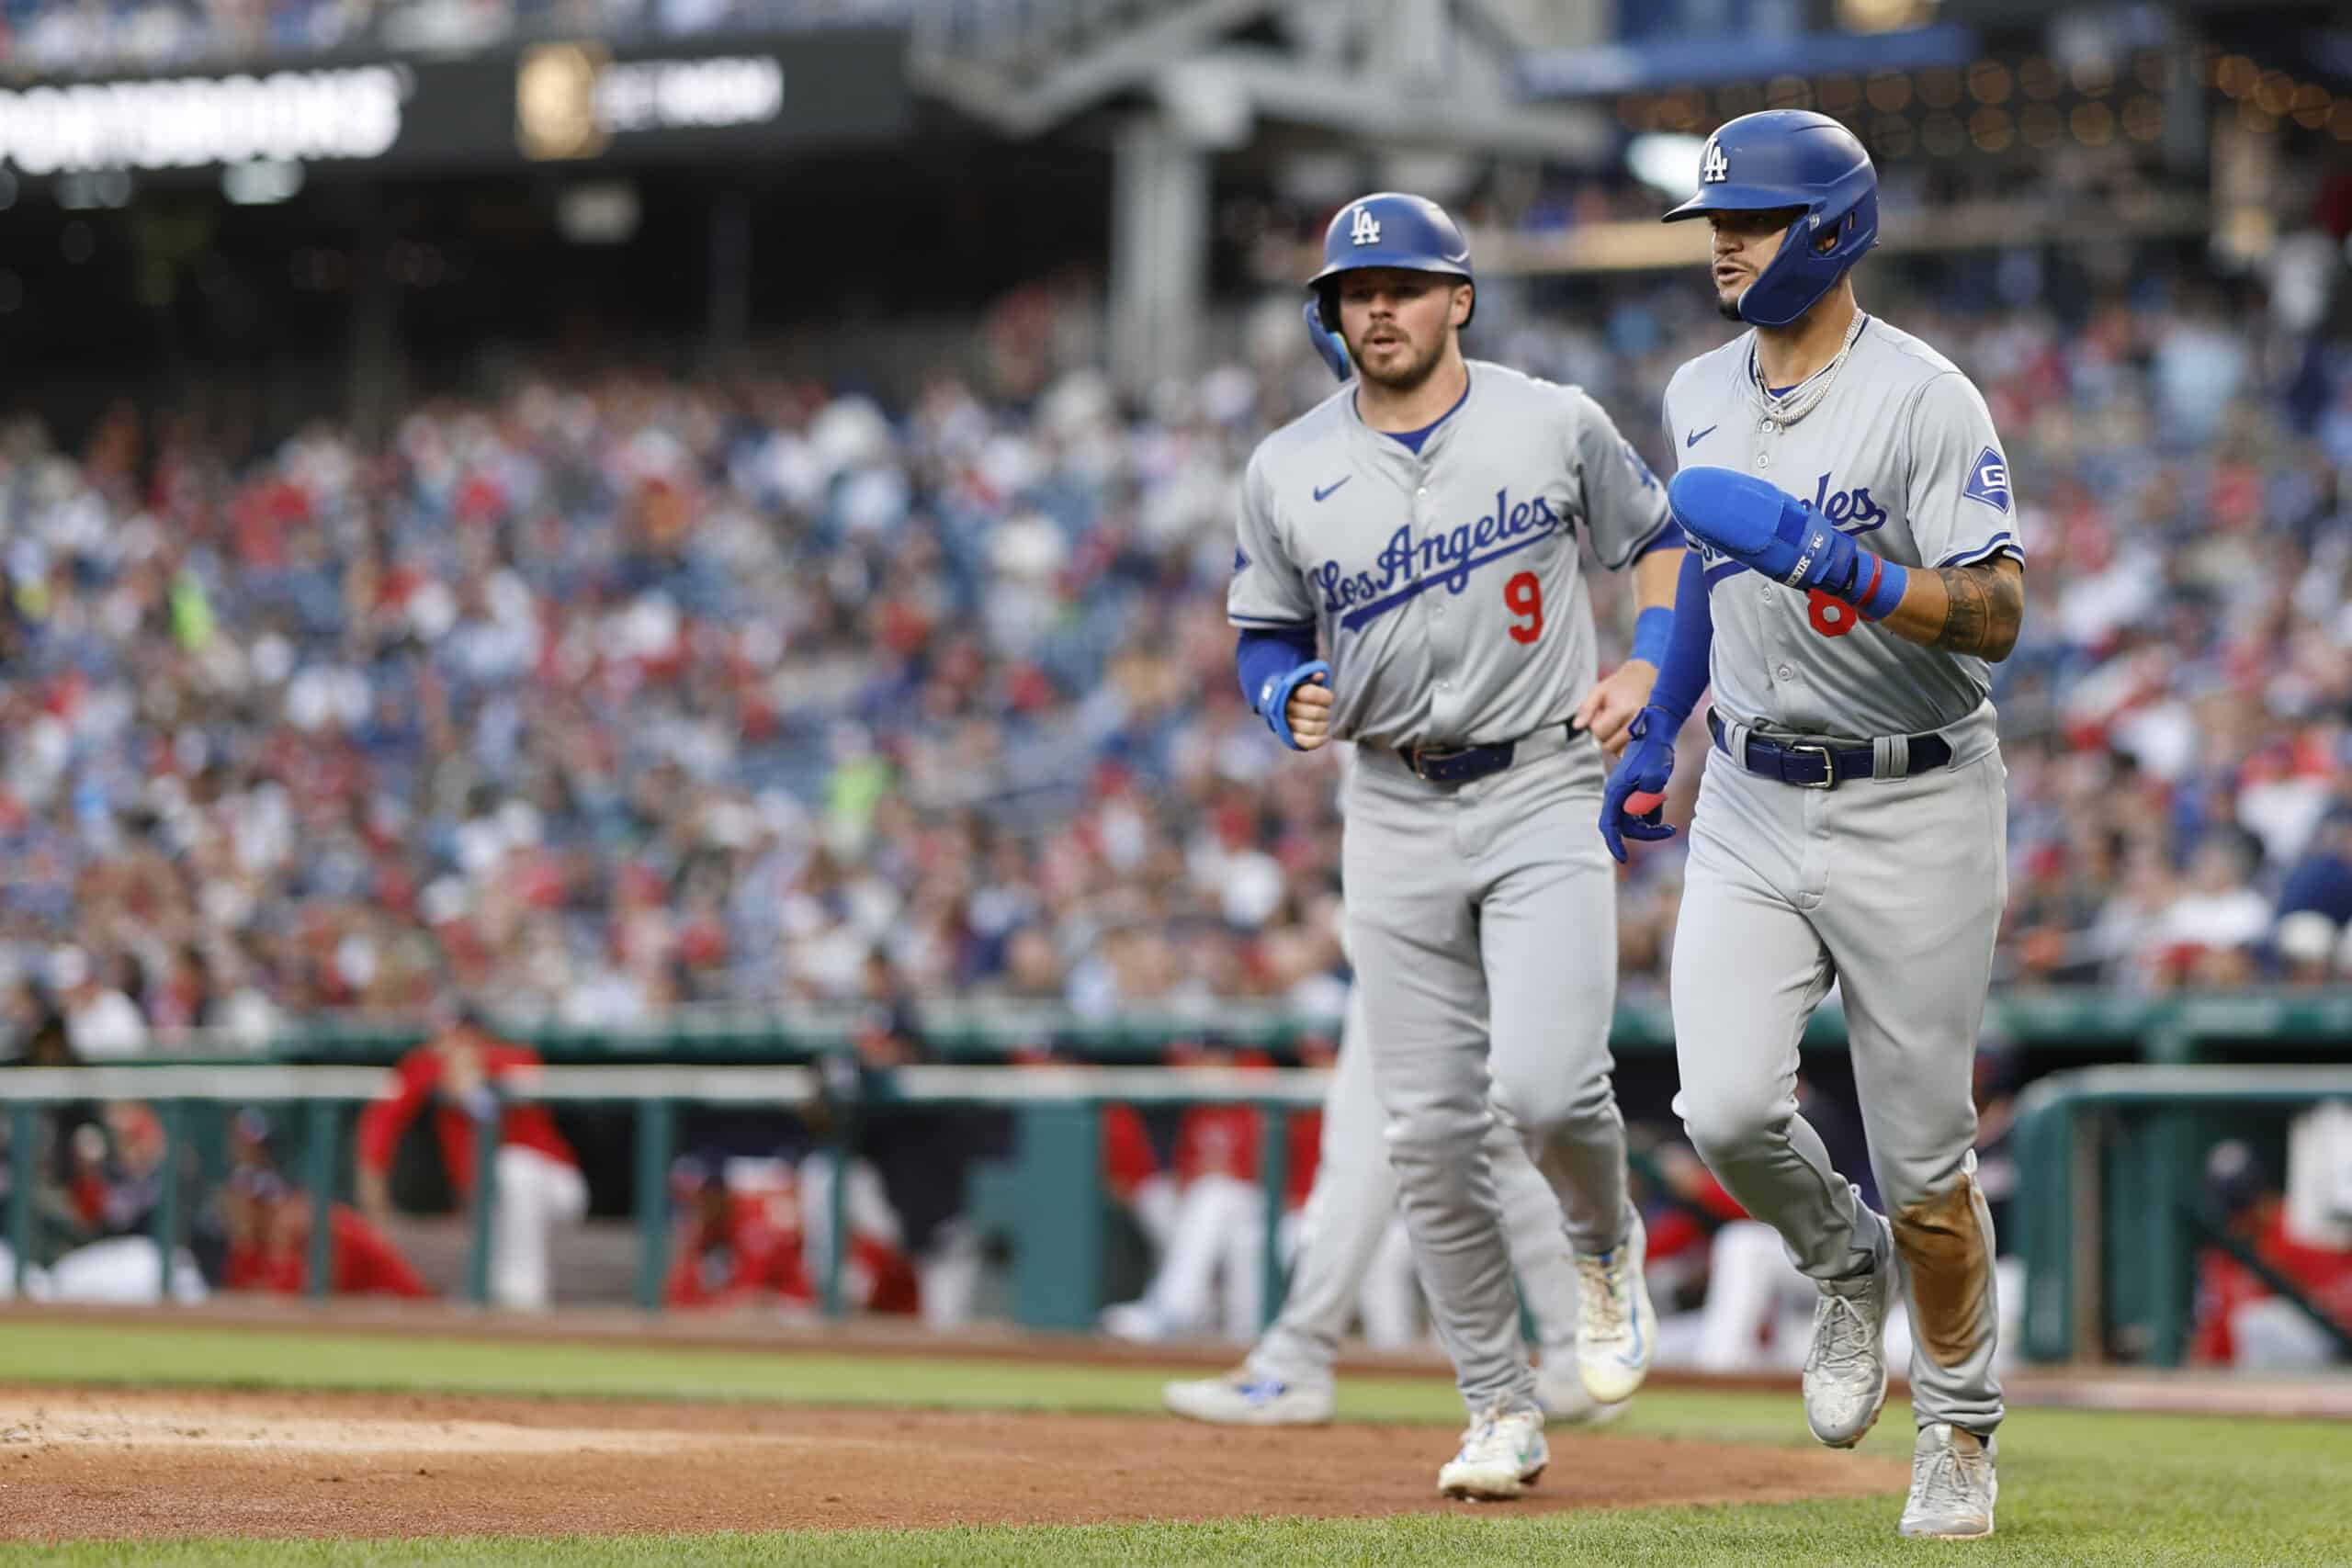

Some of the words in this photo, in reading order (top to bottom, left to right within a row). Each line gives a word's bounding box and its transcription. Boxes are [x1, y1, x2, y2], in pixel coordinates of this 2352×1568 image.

[1703, 137, 1728, 183] LA
[1351, 206, 1381, 245] LA
[1307, 559, 1376, 614] Los
[1376, 486, 1559, 595] Angeles
[1503, 570, 1544, 646] 9
